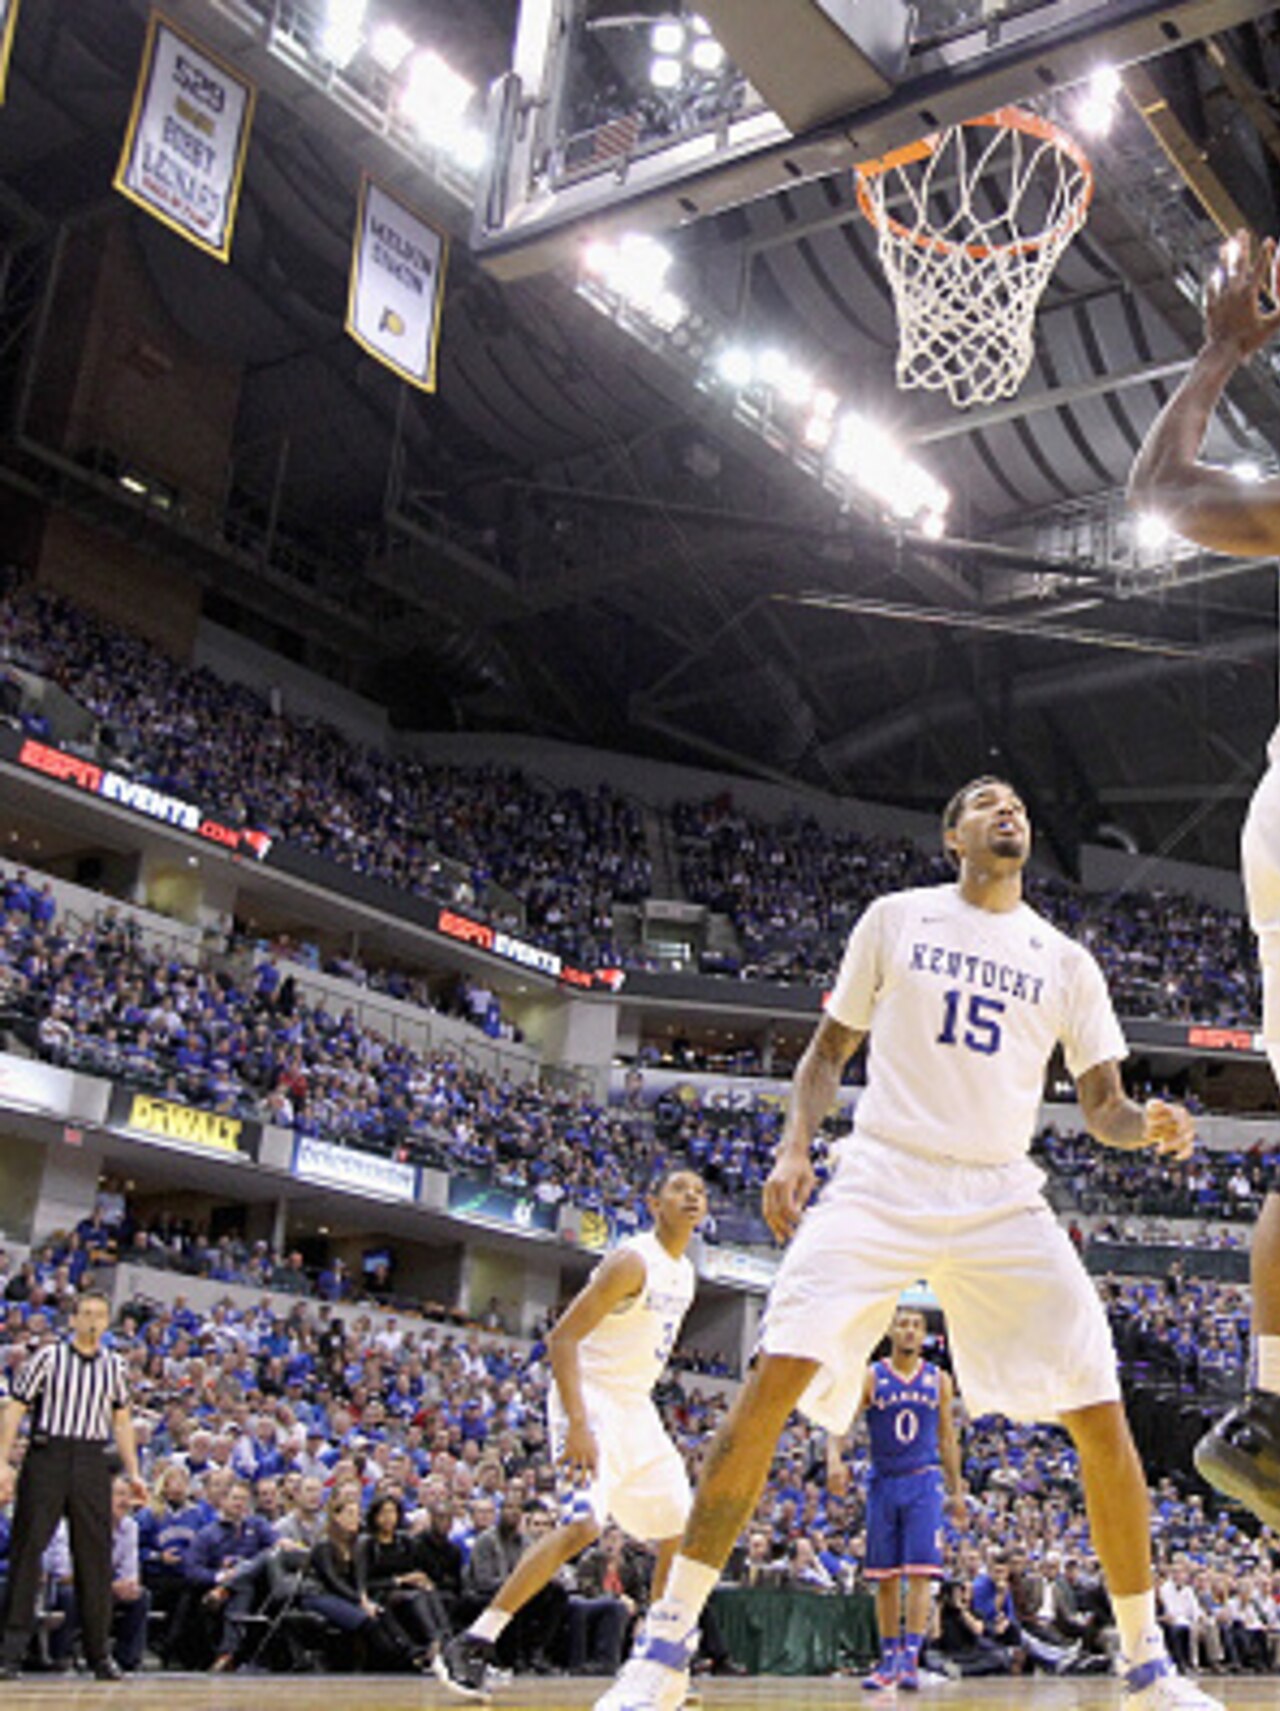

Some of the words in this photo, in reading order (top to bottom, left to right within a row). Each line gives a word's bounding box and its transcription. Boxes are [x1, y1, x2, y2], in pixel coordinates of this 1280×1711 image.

[172, 54, 225, 114] 529
[909, 942, 1044, 1005] KENTUCKY
[935, 987, 1007, 1057] 15
[894, 1406, 919, 1444] 0
